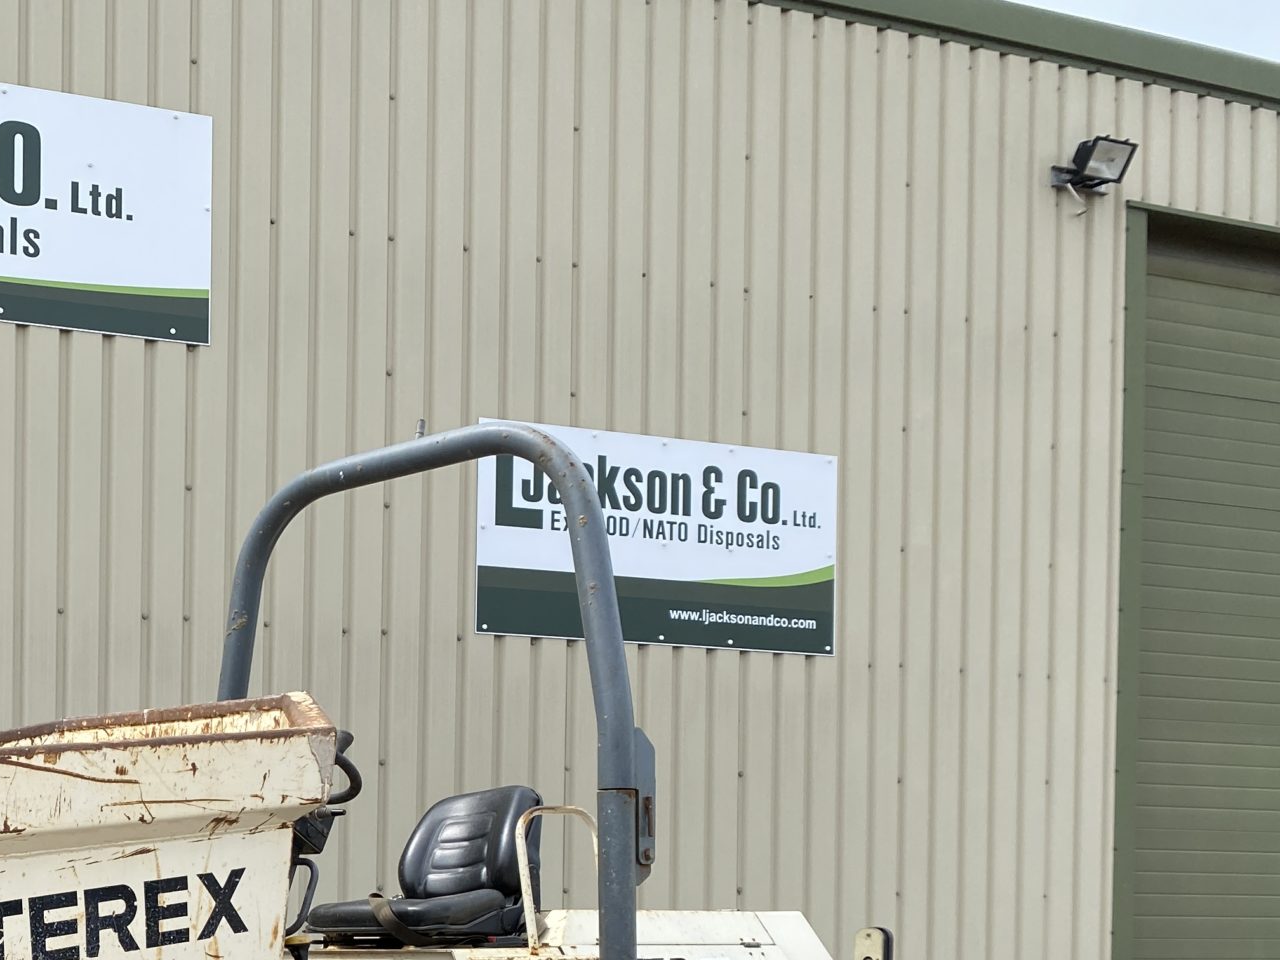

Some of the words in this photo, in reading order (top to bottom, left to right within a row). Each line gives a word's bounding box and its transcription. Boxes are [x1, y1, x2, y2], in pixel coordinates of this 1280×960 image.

[70, 181, 134, 221] Ltd.
[701, 465, 727, 520] &
[736, 469, 788, 527] Co.
[793, 510, 822, 530] Ltd.
[606, 515, 688, 542] OD/NATO
[697, 523, 780, 550] Disposals
[669, 609, 817, 630] www.ljacksonandco.com
